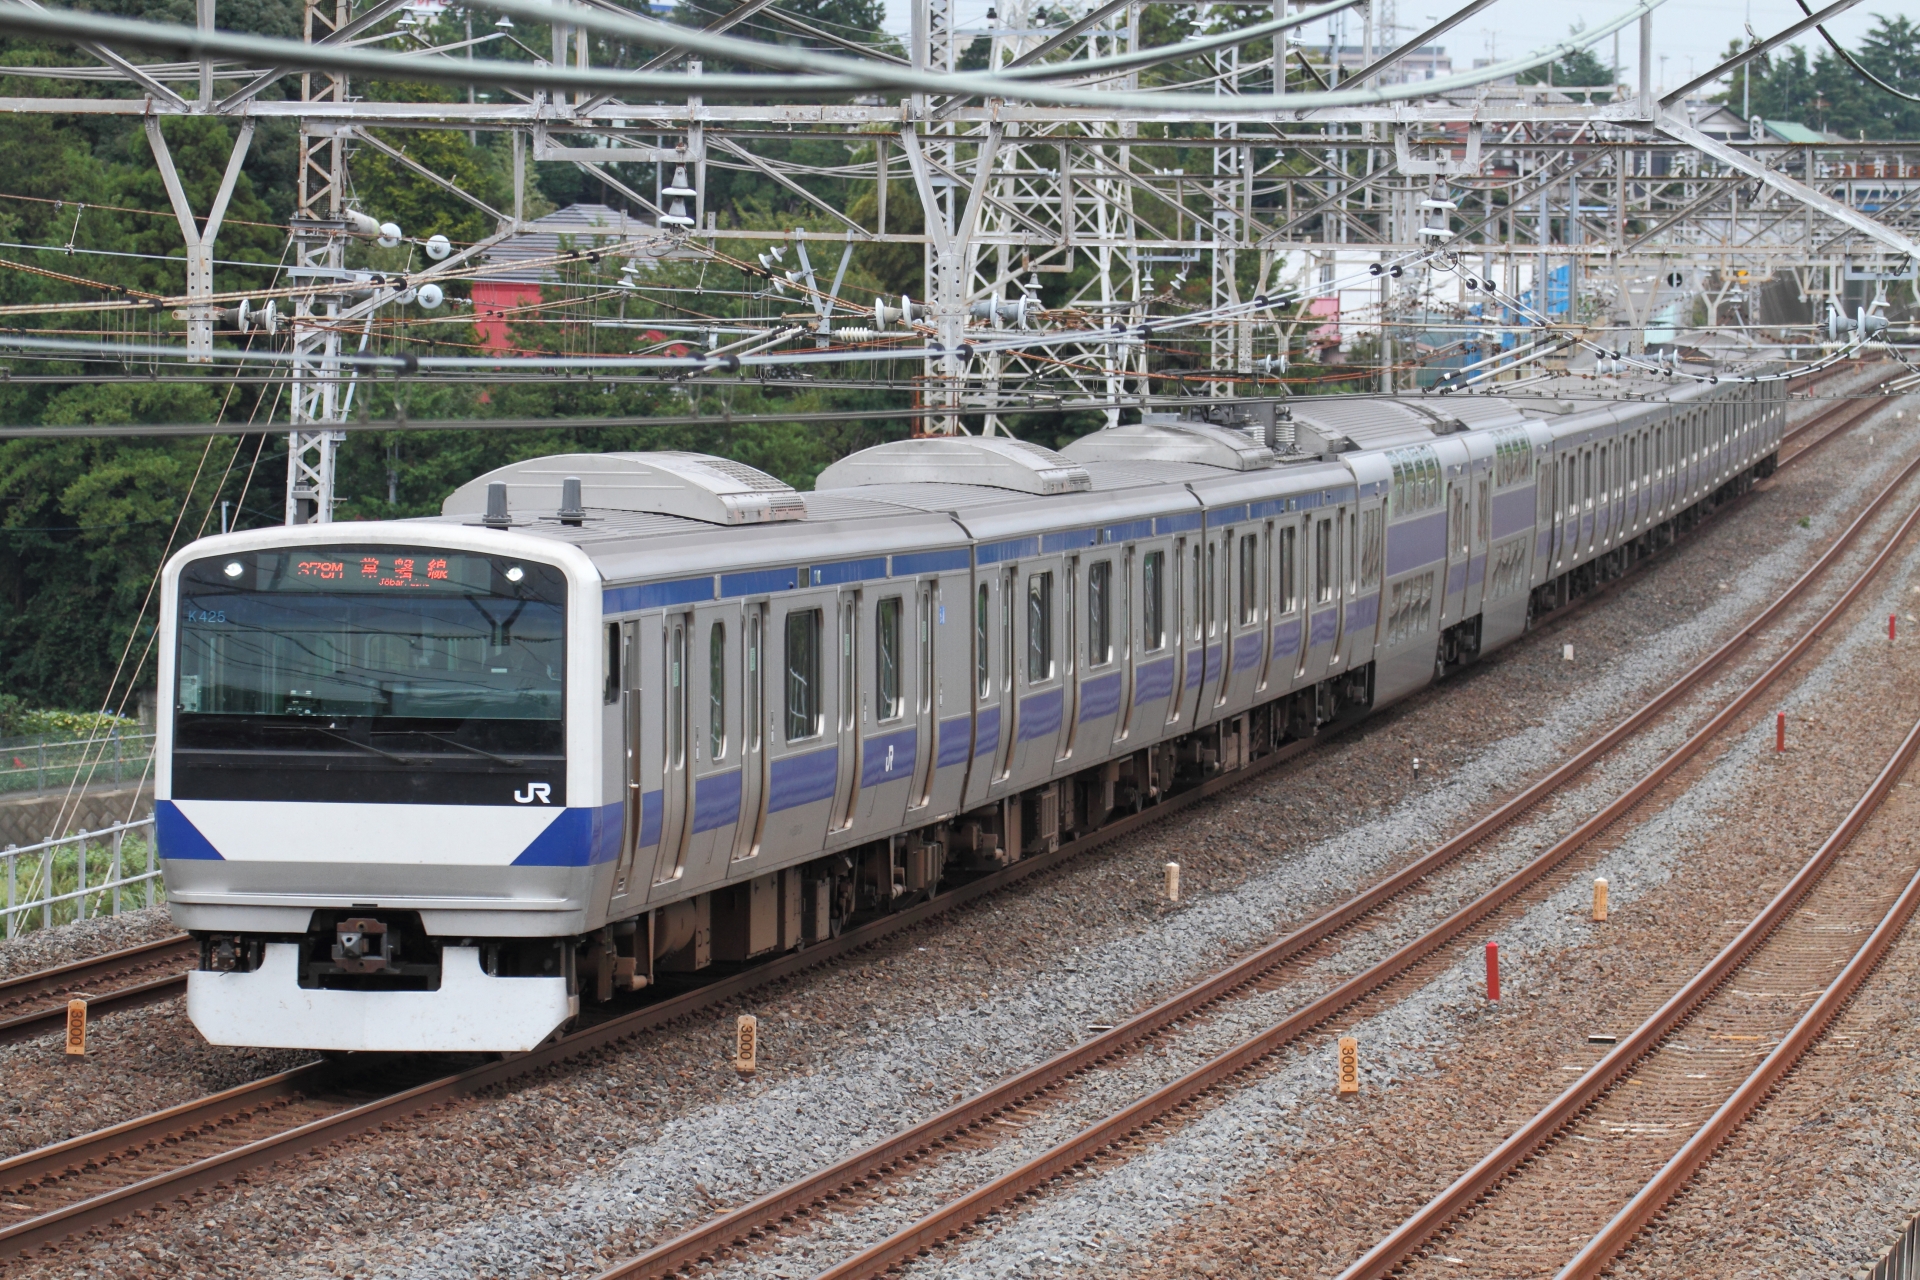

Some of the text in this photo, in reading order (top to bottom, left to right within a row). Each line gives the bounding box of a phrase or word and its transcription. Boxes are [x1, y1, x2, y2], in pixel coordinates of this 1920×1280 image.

[885, 744, 894, 773] JR
[514, 782, 551, 804] JR
[70, 1010, 83, 1046] 3000
[740, 1025, 753, 1060] 3000
[1341, 1047, 1355, 1083] 3000
